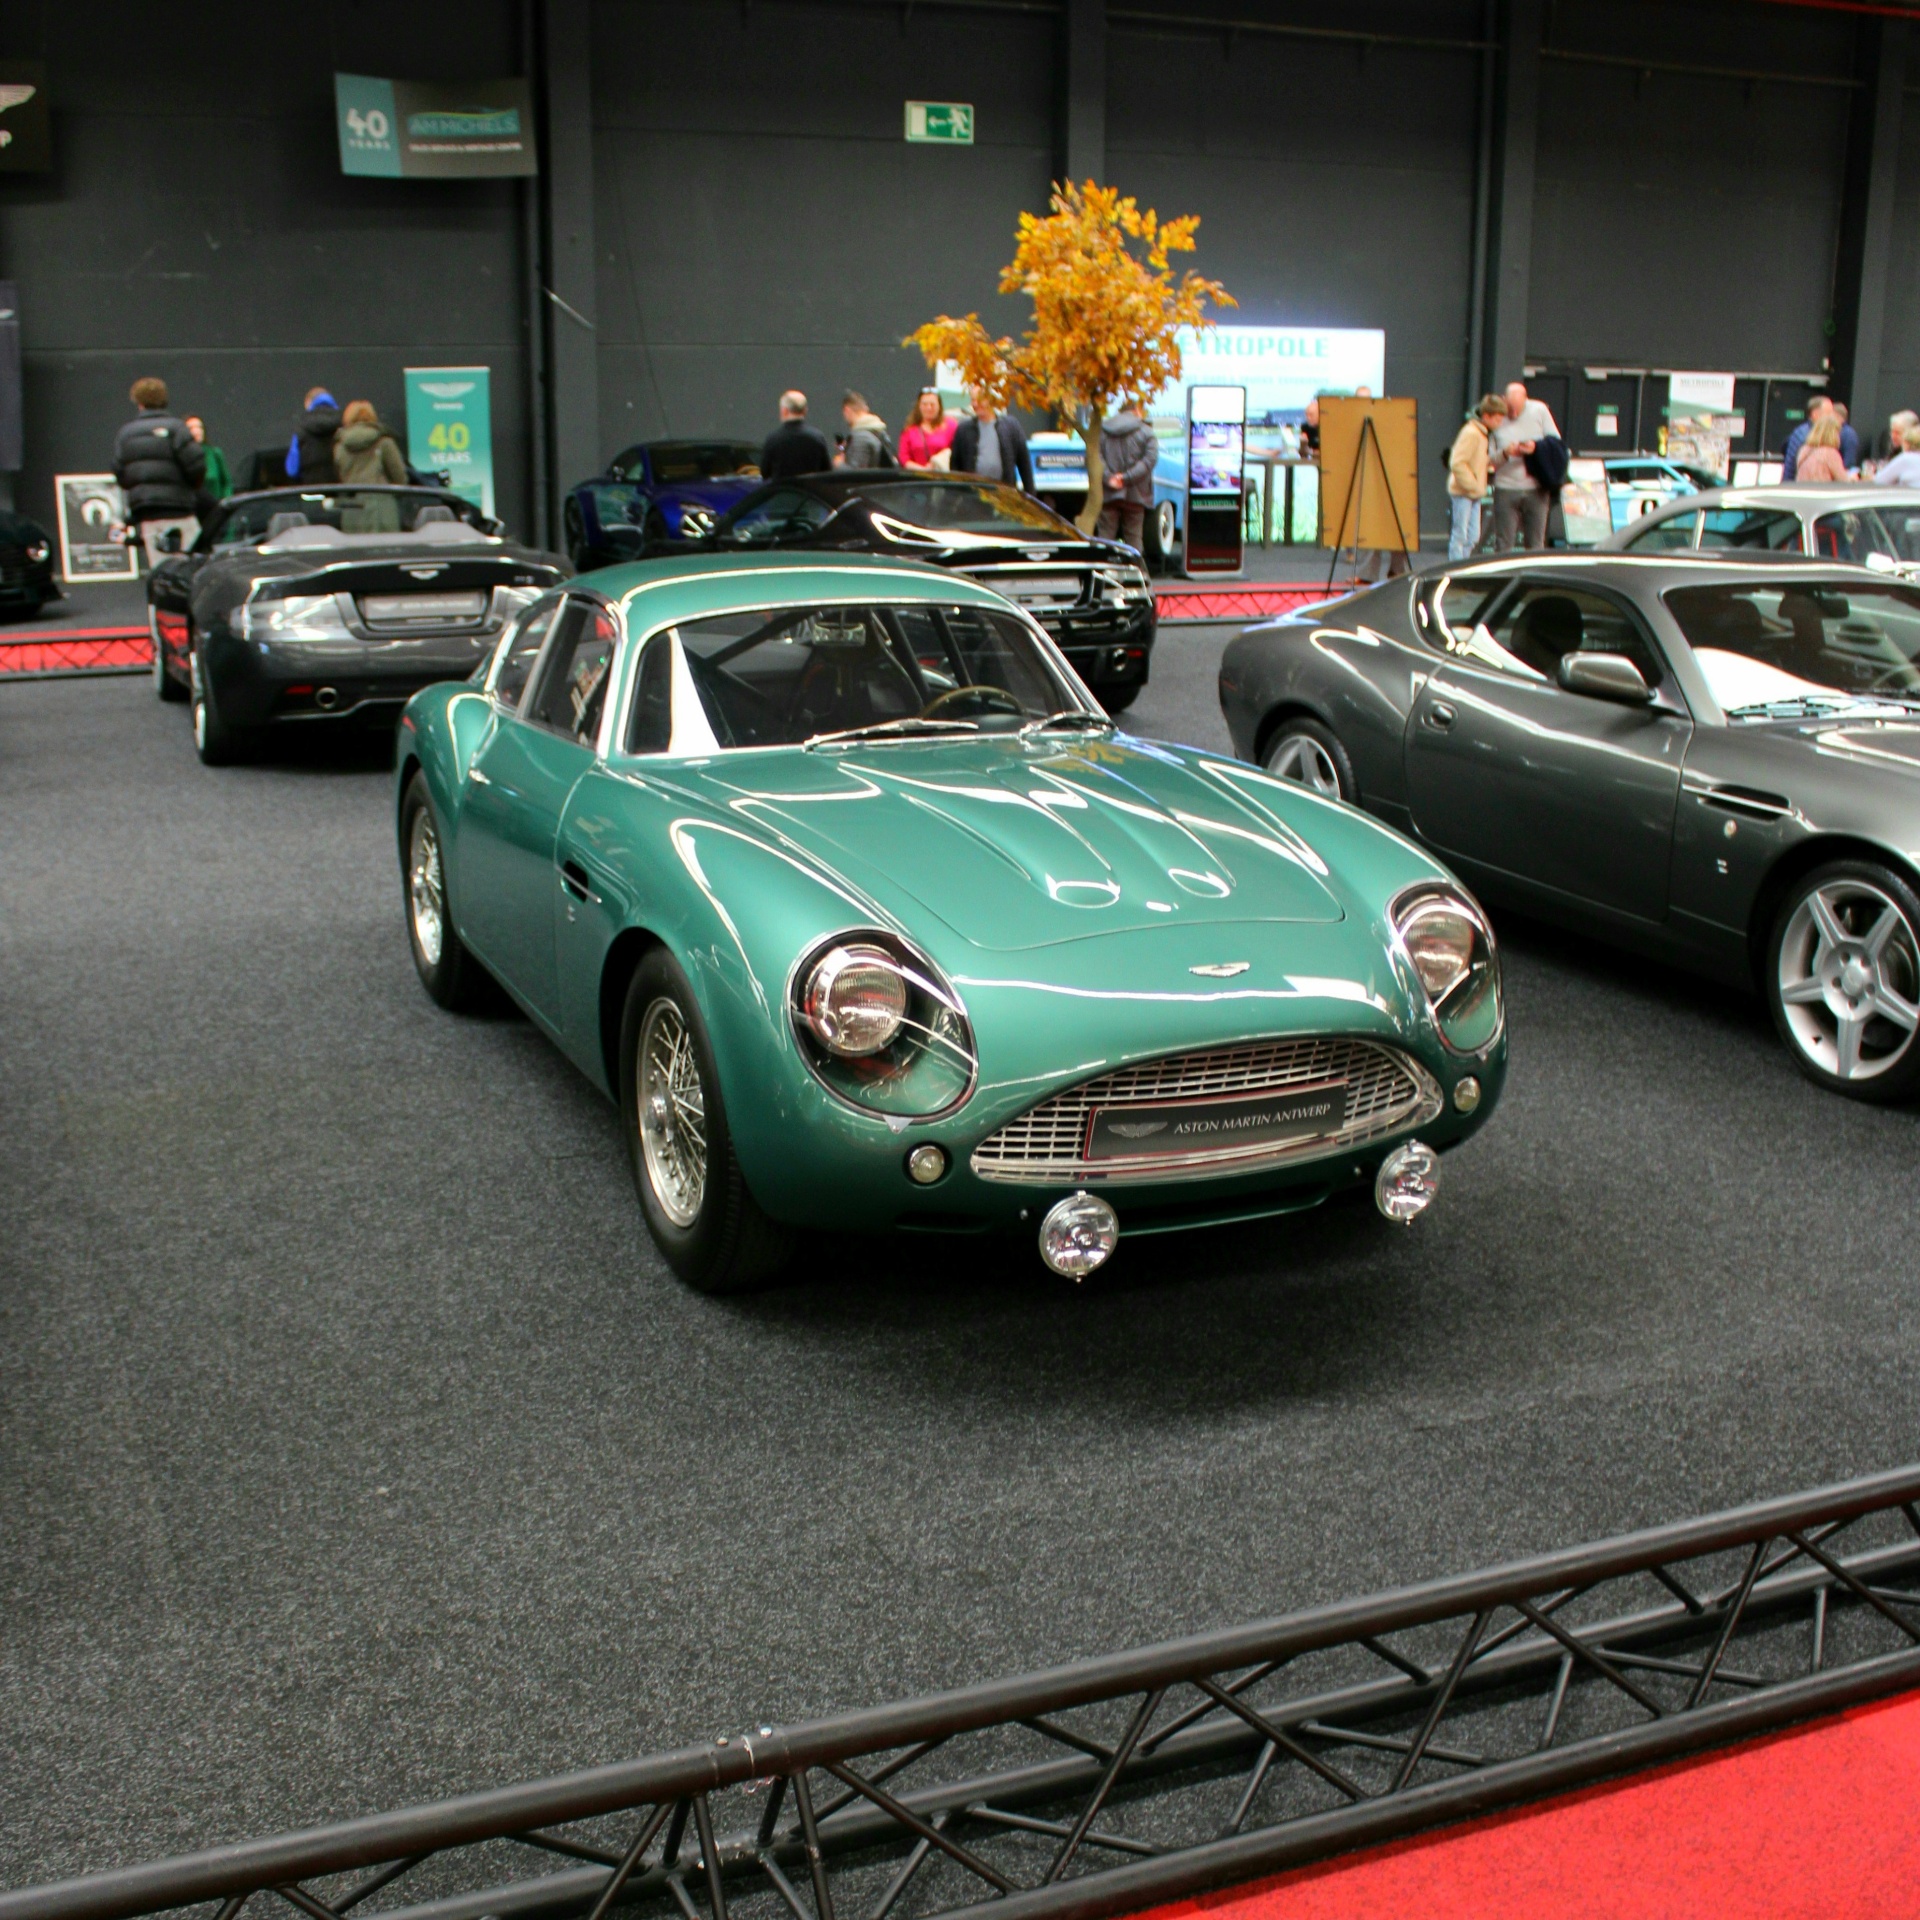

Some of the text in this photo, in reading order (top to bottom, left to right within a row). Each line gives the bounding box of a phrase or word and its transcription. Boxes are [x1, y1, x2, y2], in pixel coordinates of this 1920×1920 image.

[346, 107, 389, 139] 40
[1178, 333, 1330, 358] ETROPOLE
[428, 422, 470, 451] 40
[430, 452, 471, 464] YEARS
[1174, 1103, 1331, 1134] ASTON MARTIN ANTWERP
